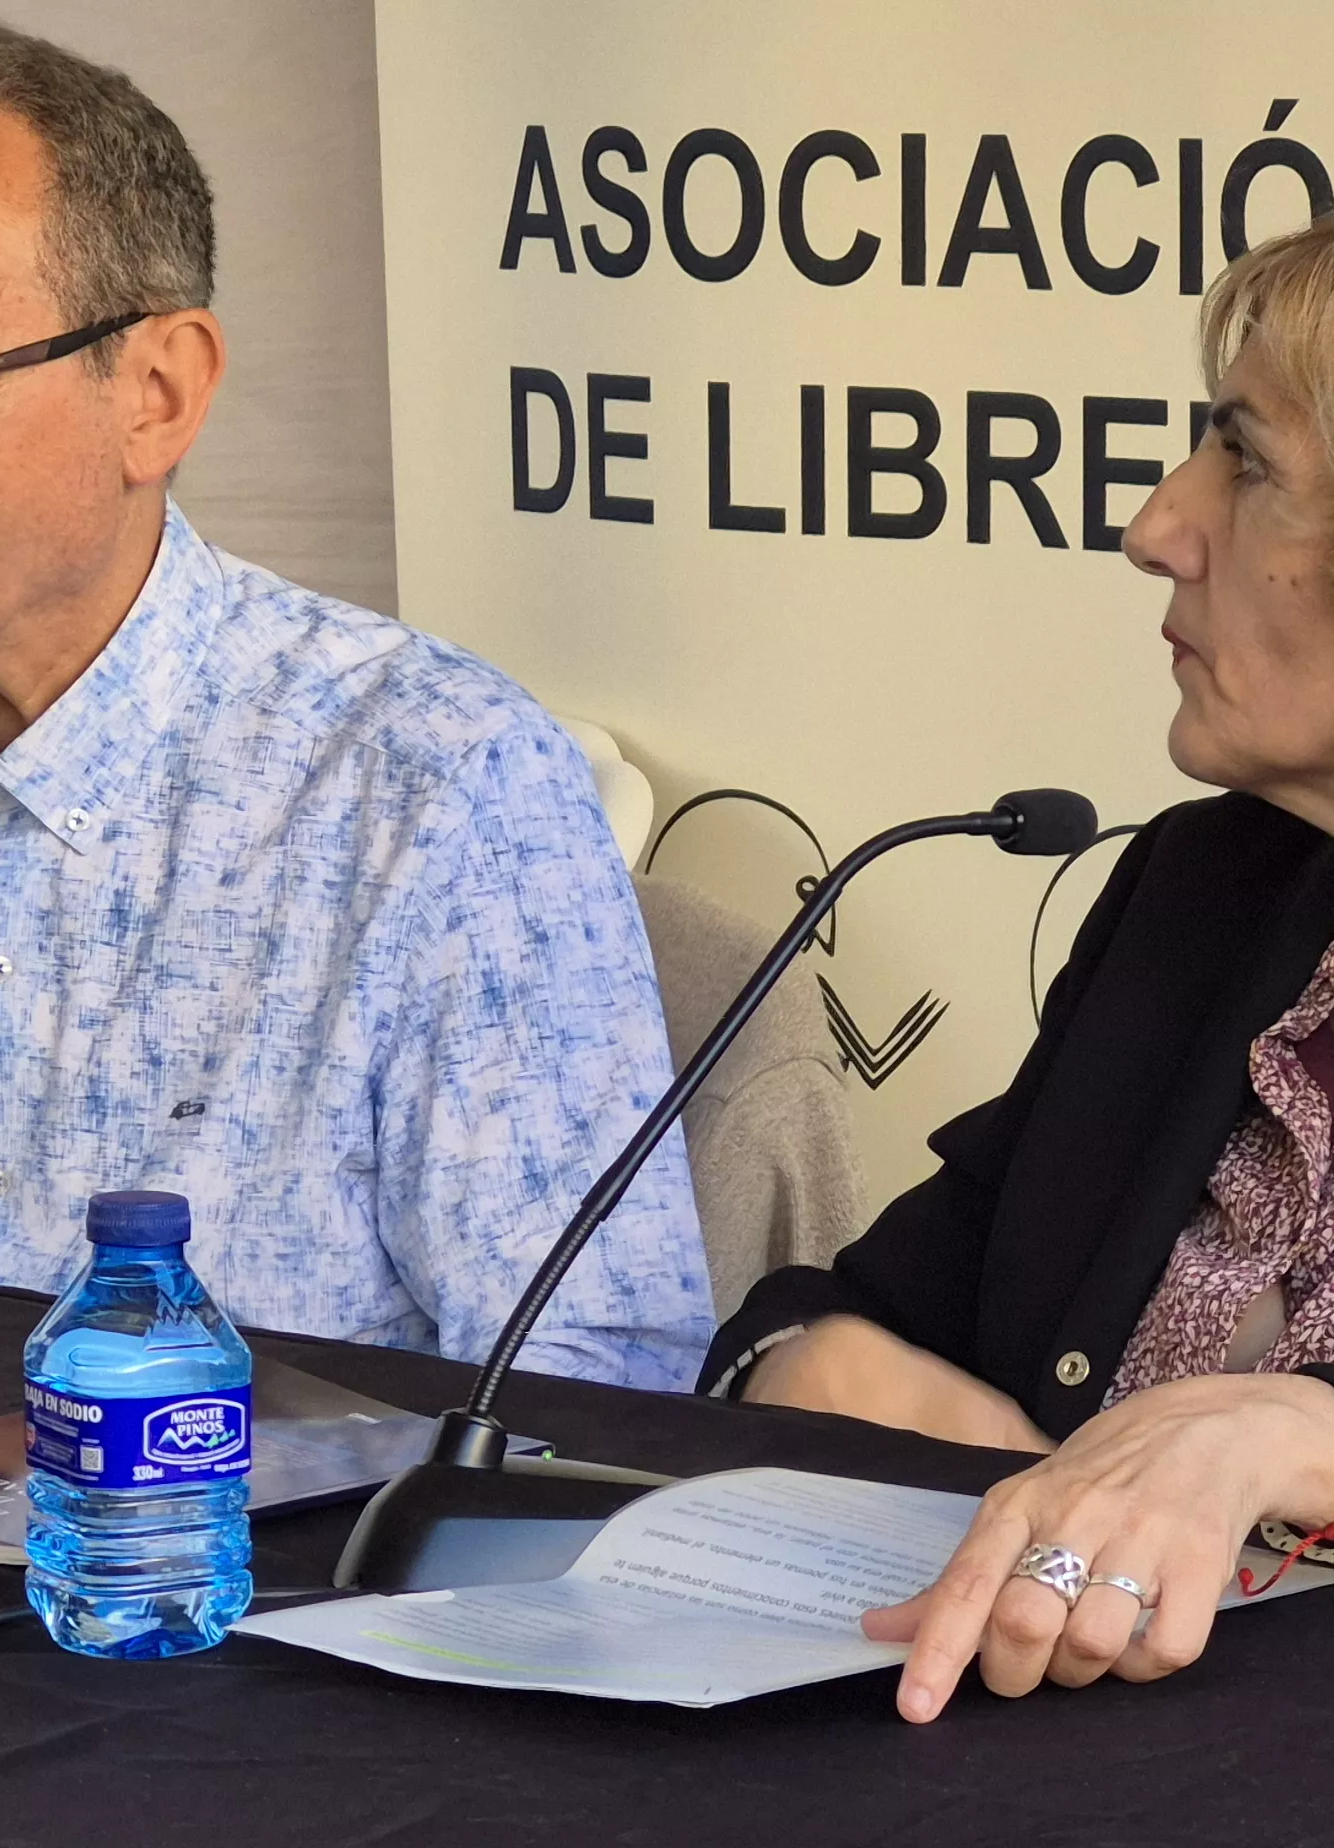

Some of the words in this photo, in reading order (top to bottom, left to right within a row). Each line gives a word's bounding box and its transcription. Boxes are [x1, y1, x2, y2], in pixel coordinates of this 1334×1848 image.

[510, 366, 655, 525] DE
[707, 380, 1212, 552] LIBRE
[45, 1393, 58, 1413] EN
[59, 1398, 103, 1423] SODIO
[170, 1406, 225, 1424] MONTE
[176, 1420, 225, 1437] PINOS
